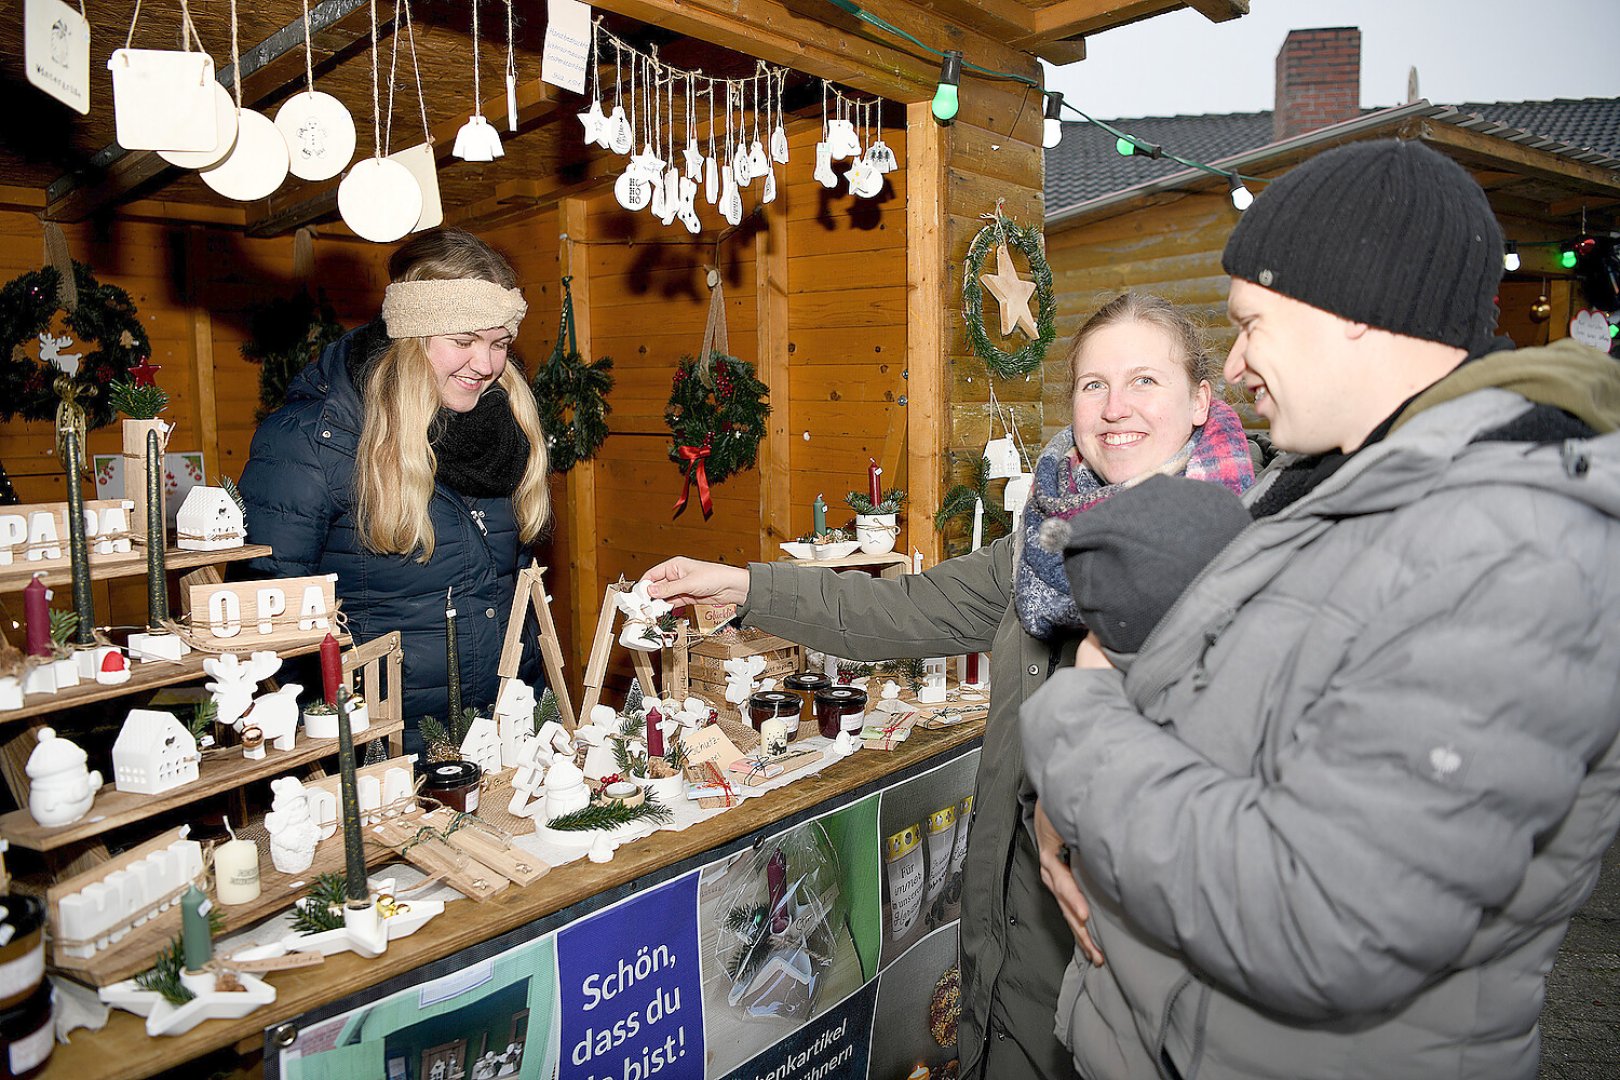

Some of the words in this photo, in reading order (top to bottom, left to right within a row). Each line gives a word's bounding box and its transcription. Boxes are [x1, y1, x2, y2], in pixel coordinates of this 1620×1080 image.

[628, 187, 642, 196] HO
[628, 196, 642, 205] HO
[208, 585, 330, 638] OPA
[901, 864, 915, 879] Für
[582, 944, 676, 1011] Schön,
[572, 1011, 640, 1066] dass
[646, 986, 681, 1025] du
[623, 1026, 686, 1080] bist!
